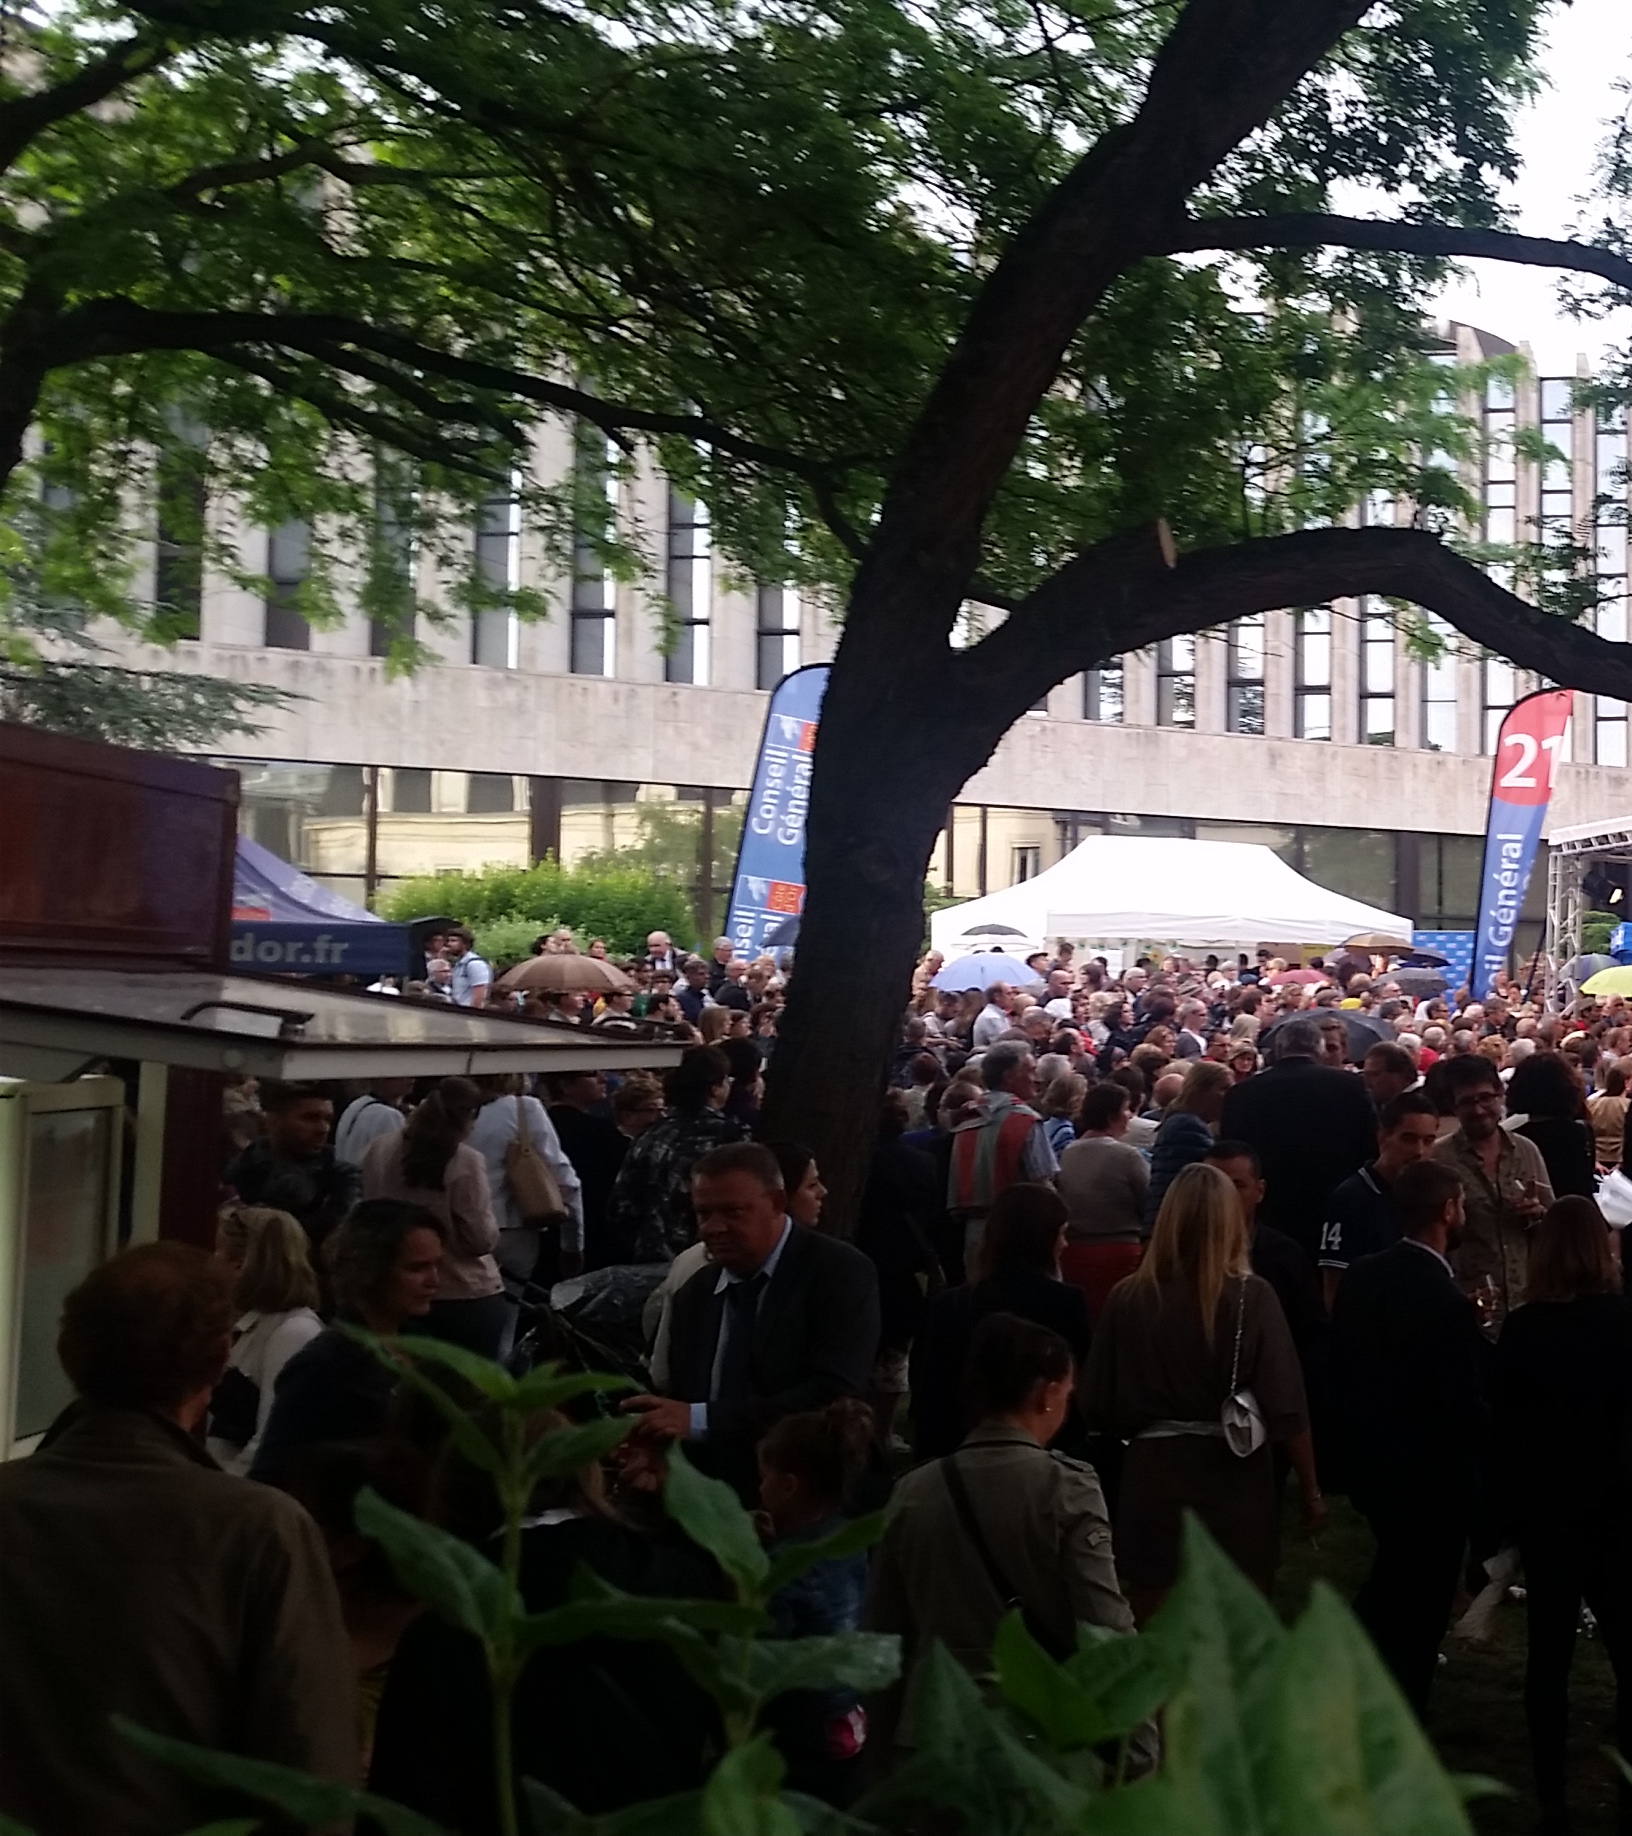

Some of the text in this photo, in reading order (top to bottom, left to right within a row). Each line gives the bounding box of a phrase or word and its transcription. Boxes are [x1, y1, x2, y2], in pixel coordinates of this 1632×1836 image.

[1500, 733, 1563, 788] 21
[752, 749, 788, 835] Conseil
[777, 751, 813, 846] Général
[1489, 832, 1524, 947] Général
[229, 932, 349, 963] dor.fr
[733, 910, 756, 963] nseil
[1319, 1222, 1342, 1250] 14
